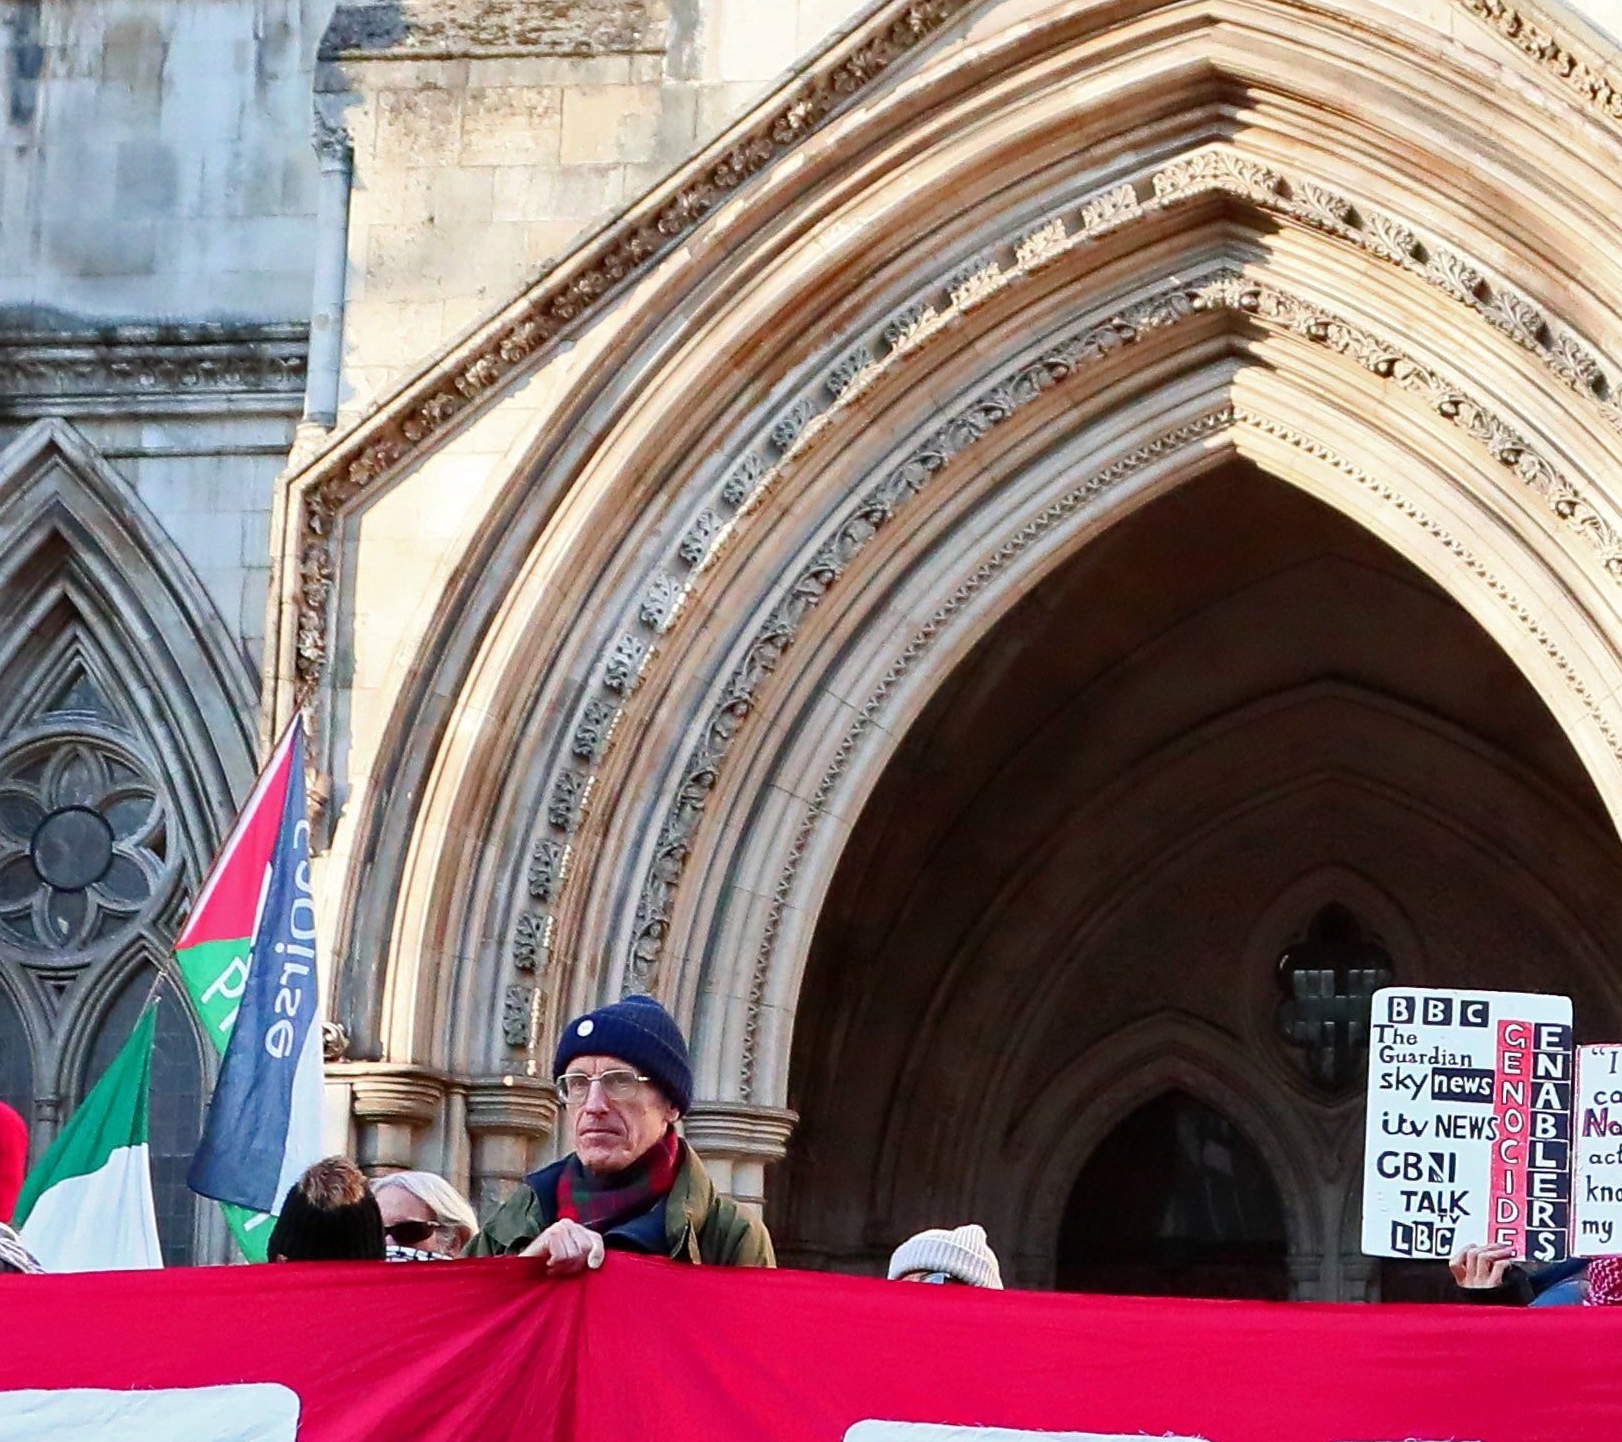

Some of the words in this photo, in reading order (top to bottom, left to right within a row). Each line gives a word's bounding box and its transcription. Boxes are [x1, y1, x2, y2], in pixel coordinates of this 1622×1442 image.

[1390, 996, 1486, 1025] BBC
[1373, 1024, 1418, 1045] The
[1379, 1045, 1472, 1067] Guardian
[1379, 1067, 1429, 1101] sky
[1433, 1073, 1493, 1096] news
[1382, 1111, 1429, 1138] itv
[1435, 1115, 1499, 1141] NEWS
[1533, 1026, 1564, 1262] ENABLERS
[1400, 1190, 1471, 1216] TALK
[1438, 1214, 1461, 1225] TV
[1582, 1219, 1613, 1243] my
[1391, 1220, 1456, 1256] LBC
